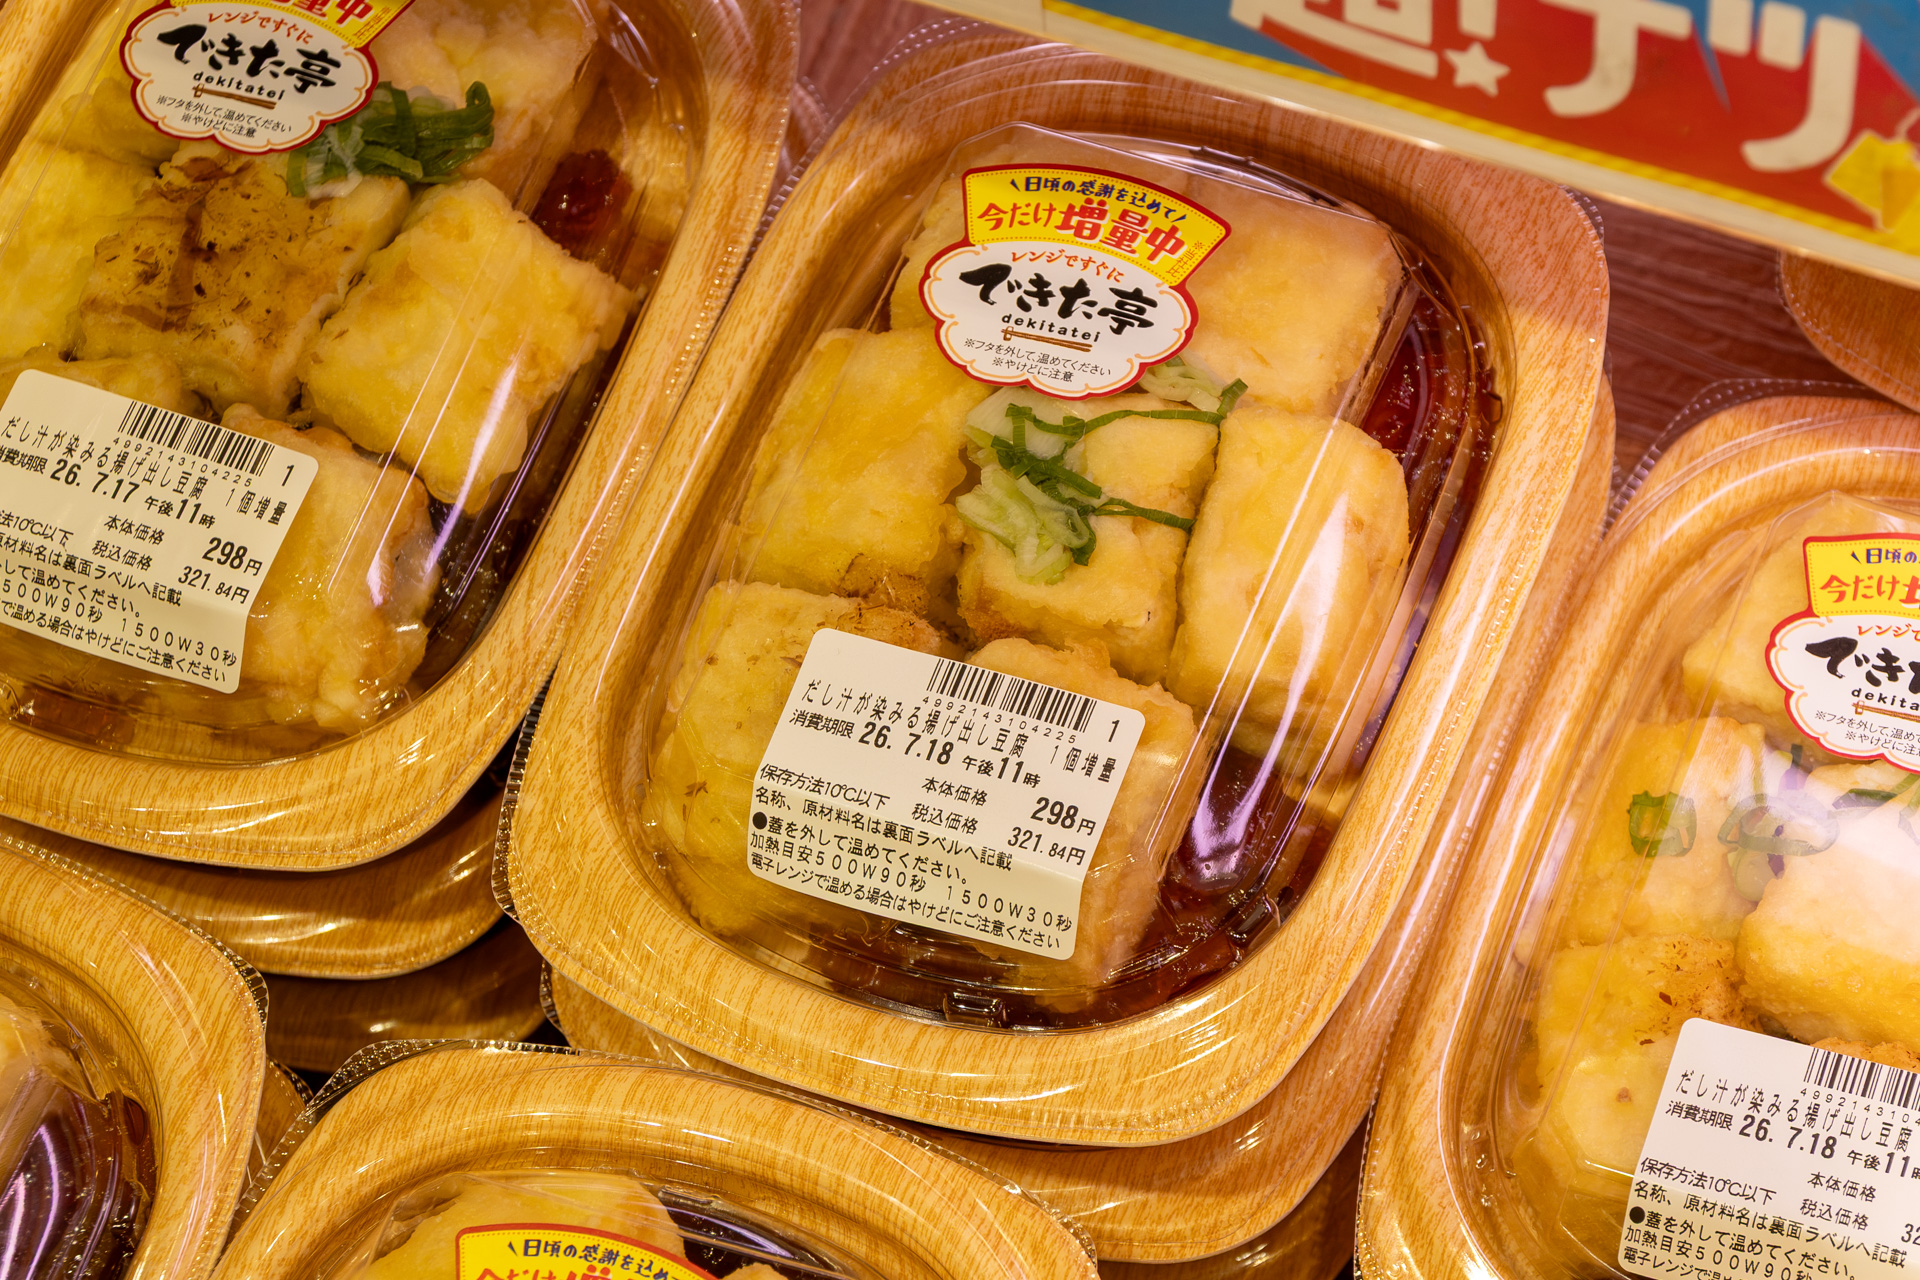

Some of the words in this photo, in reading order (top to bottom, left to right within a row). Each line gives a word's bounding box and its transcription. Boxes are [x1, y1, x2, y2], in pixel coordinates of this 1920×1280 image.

[208, 11, 313, 44] レンジですぐに
[157, 23, 341, 95] できた亭
[192, 71, 284, 100] dekitatei
[1024, 176, 1177, 217] 日頃の感謝を込めて
[977, 197, 1186, 261] 今だけ増量中
[1011, 249, 1125, 283] レンジですぐに
[959, 263, 1158, 335] できた亭
[1002, 313, 1101, 342] dekitatei
[992, 357, 1075, 383] ※やけどに注意
[1, 416, 208, 500] だし汁が染みる揚げ出し豆腐
[113, 437, 252, 487] 4992143104225
[282, 464, 295, 487] 1
[144, 496, 216, 530] 午後11時
[104, 514, 166, 546] 本体価格
[202, 537, 263, 577] 298円
[1865, 547, 1920, 564] 日頃の
[0, 558, 140, 618] して温めてください。
[92, 540, 153, 571] 税込価格
[178, 565, 250, 604] 321.84円
[802, 679, 1029, 758] だし汁が染みる揚げ出し豆腐
[922, 696, 1077, 745] 4992143104225
[1108, 720, 1121, 743] 1
[789, 709, 855, 739] 消費期限
[962, 755, 1041, 789] 午後11時
[1845, 731, 1920, 757] ※やけどに注
[760, 763, 891, 810] 保存方法10℃以下
[922, 777, 988, 807] 本体価格
[1031, 796, 1096, 836] 298円
[911, 803, 979, 835] 税込価格
[1007, 826, 1086, 866] 321.84円
[751, 851, 1061, 949] 電子レンジで温める場合はやけどにご注意ください
[1665, 1099, 1734, 1131] 消費期限
[1676, 1069, 1913, 1153] だし汁が染みる揚げ出し豆腐
[1640, 1156, 1777, 1206] 保存方法10℃以下
[1807, 1171, 1877, 1203] 本体価格
[1800, 1198, 1869, 1231] 税込価格
[523, 1239, 679, 1280] 日頃の感謝を込め
[1623, 1246, 1732, 1280] 電子レンジで温
